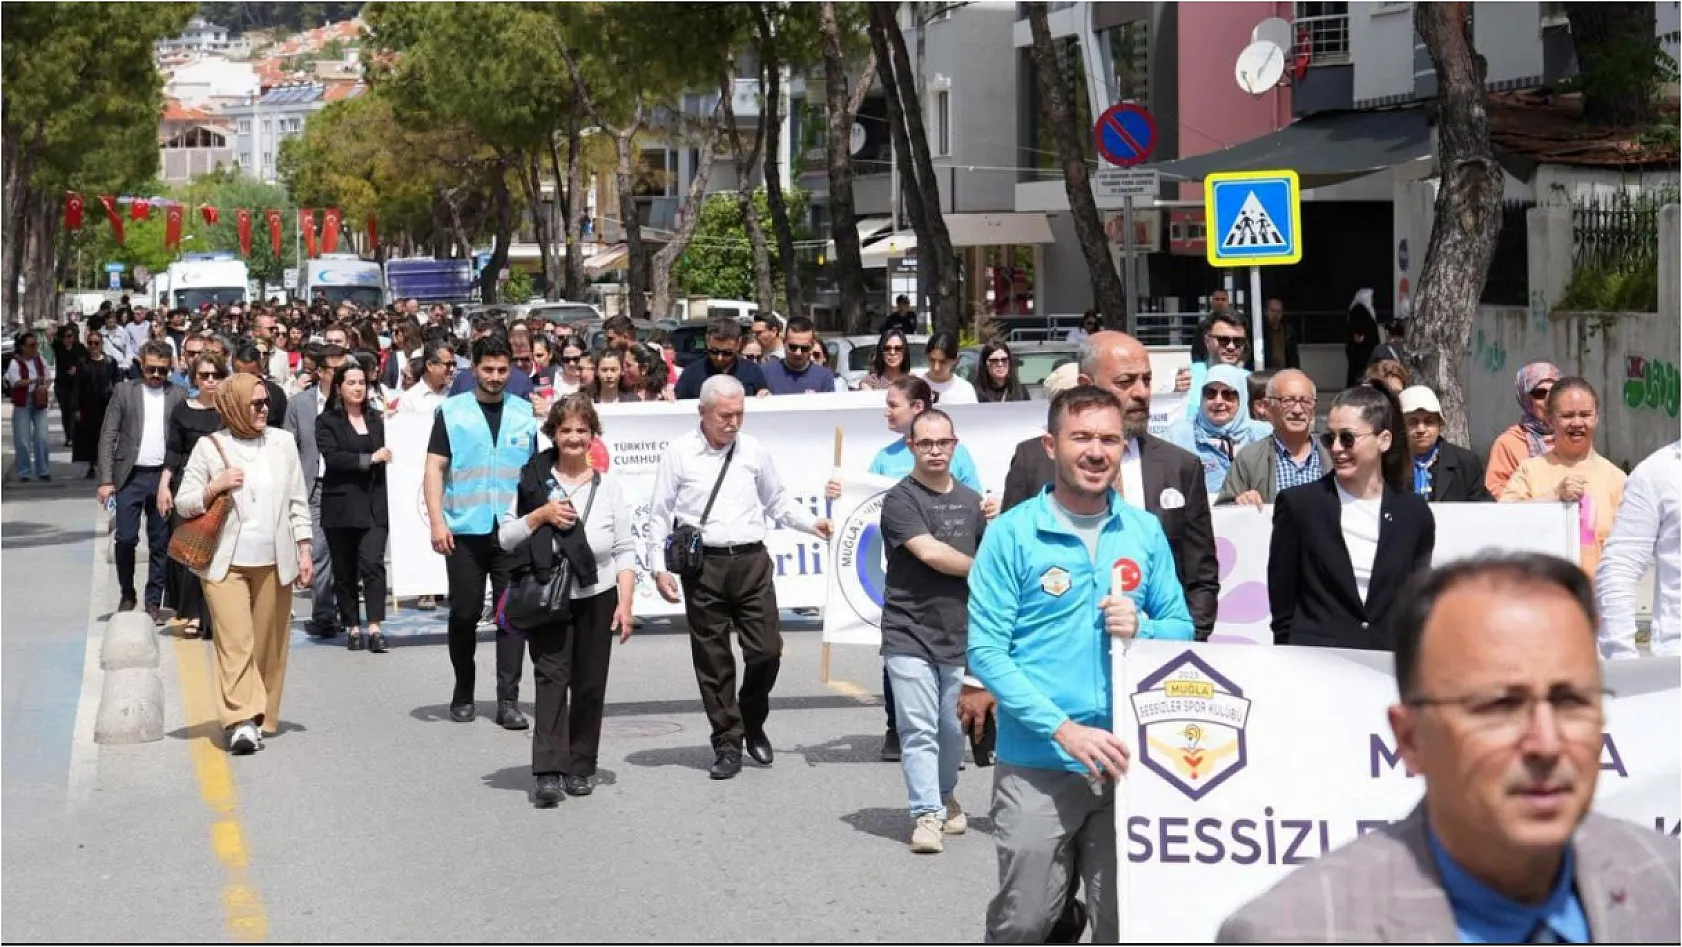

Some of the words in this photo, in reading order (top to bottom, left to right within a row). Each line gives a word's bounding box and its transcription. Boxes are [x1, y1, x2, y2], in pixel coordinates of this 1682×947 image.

[614, 441, 657, 451] TÜRKİYE
[1171, 683, 1209, 695] MUĞLA
[1140, 700, 1181, 717] SESSİZLER
[1184, 700, 1206, 713] SPOR
